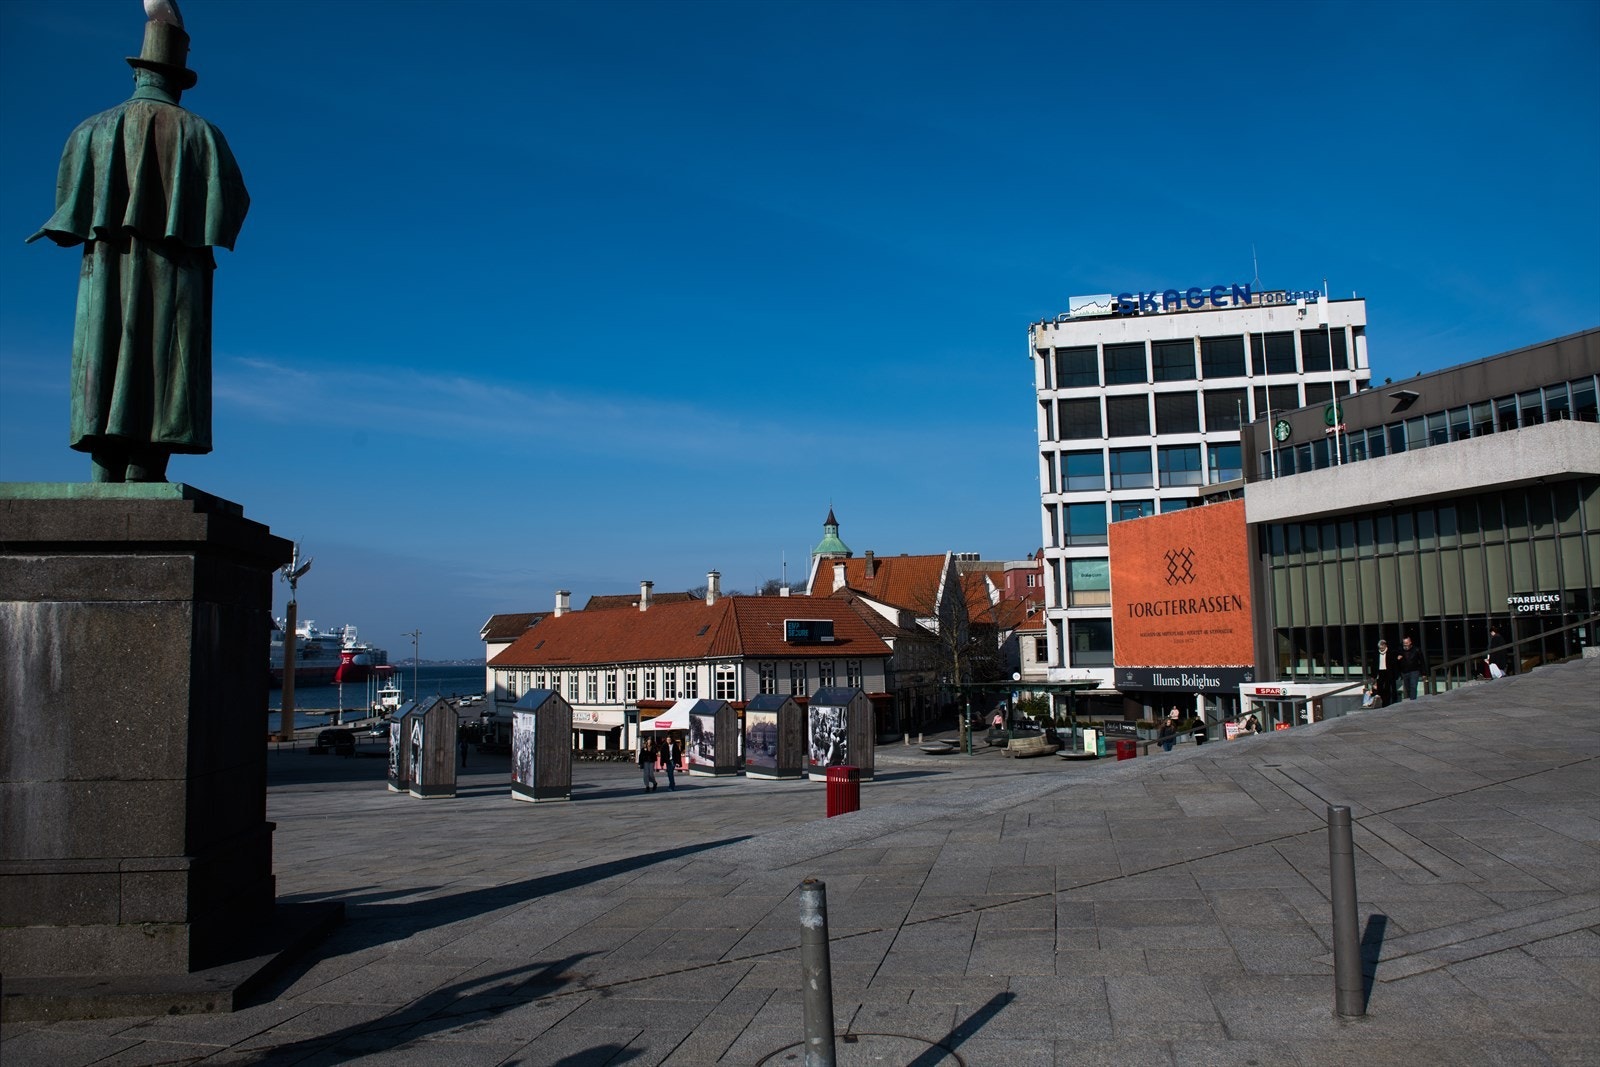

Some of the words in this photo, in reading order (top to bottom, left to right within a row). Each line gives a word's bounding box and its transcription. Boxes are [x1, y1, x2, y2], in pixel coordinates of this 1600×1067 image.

[1116, 283, 1251, 315] SKAGEN
[1127, 594, 1243, 618] TORGTERRASSEN
[1507, 594, 1560, 605] STARBUCKS
[1517, 603, 1551, 612] COFFEE
[1153, 673, 1180, 687] Illums
[1181, 673, 1221, 690] Bolighus
[1260, 687, 1281, 695] SPAR
